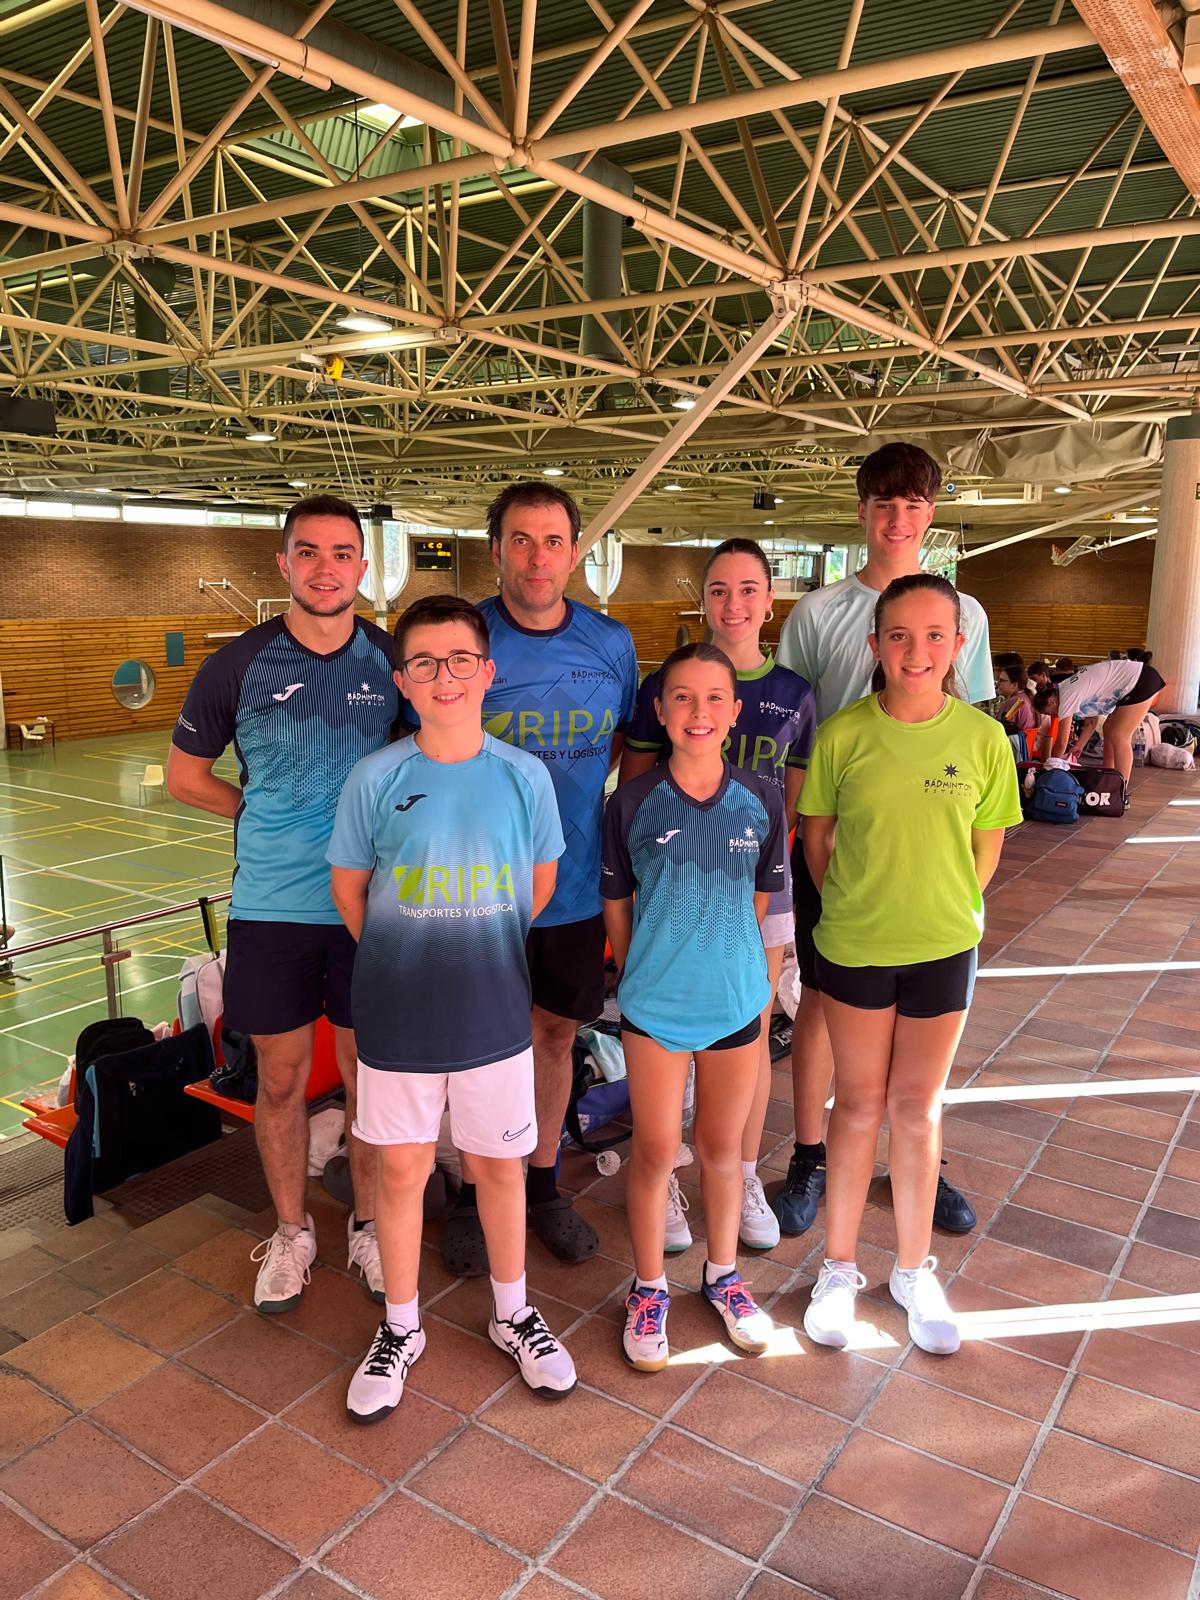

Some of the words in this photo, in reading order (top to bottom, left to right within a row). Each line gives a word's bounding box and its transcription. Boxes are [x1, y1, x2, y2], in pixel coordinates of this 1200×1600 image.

[518, 708, 615, 747] RIPA
[1084, 791, 1111, 807] OR
[427, 863, 515, 904] RIPA
[399, 904, 462, 919] TRANSPORTES
[463, 908, 471, 918] Y
